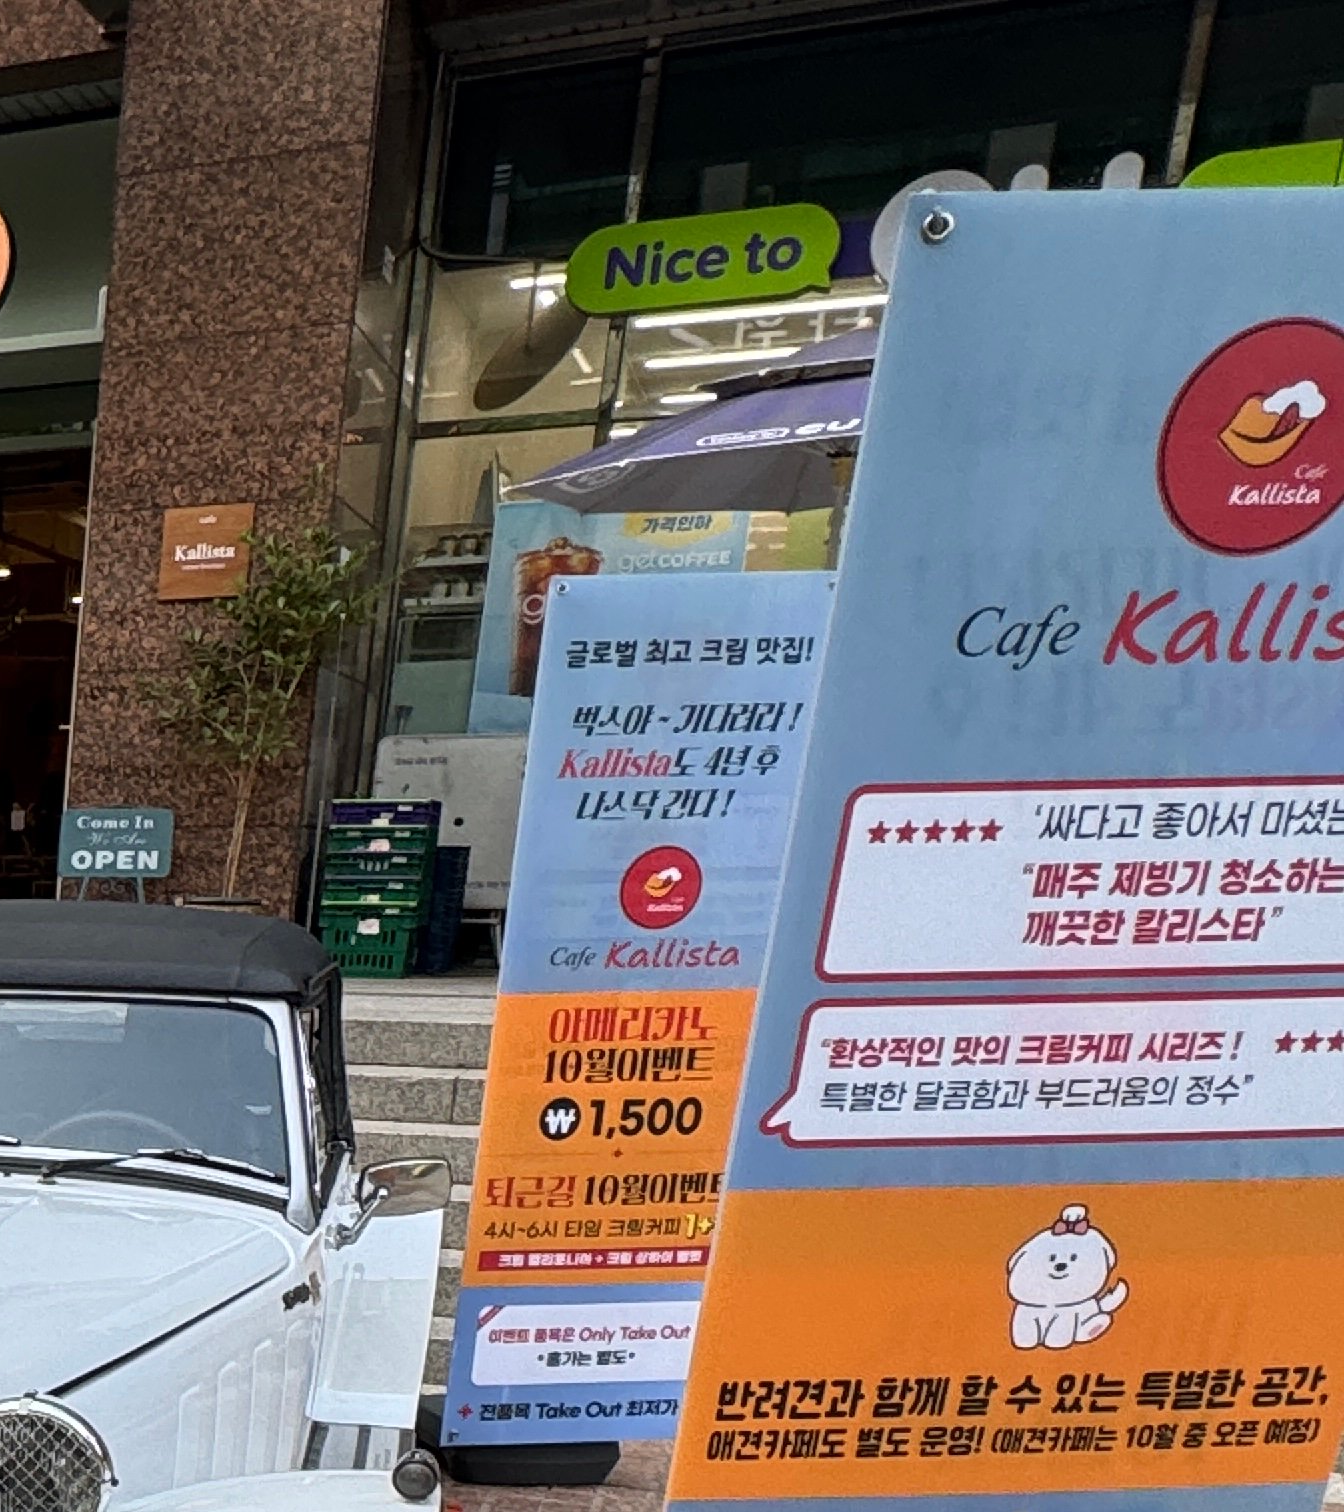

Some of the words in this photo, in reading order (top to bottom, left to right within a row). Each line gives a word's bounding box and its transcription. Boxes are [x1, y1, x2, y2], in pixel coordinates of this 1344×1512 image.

[603, 240, 730, 290] Nice
[744, 232, 803, 275] to
[1226, 483, 1323, 506] Kallista
[174, 542, 236, 561] Kallista
[566, 640, 638, 668] 글로벌
[643, 639, 692, 666] 최고
[699, 638, 749, 666] 크림
[756, 636, 815, 665] 맛집!
[955, 603, 1082, 672] Cafe
[76, 815, 130, 829] Come
[134, 815, 154, 829] In
[1152, 800, 1254, 840] 좋아서
[70, 850, 159, 870] OPEN
[1108, 858, 1212, 898] 제빙기
[1021, 909, 1126, 948] 깨끗한
[549, 945, 597, 972] Cafe
[603, 939, 740, 969] Kallista
[548, 1005, 718, 1044] 아메리카노
[952, 1032, 1012, 1068] 맛의
[1015, 1030, 1131, 1066] 크림커피
[819, 1079, 908, 1115] 특별한
[912, 1078, 1030, 1113] 달콤함과
[1035, 1075, 1180, 1110] 부드러움의
[590, 1097, 704, 1141] 1,500
[484, 1174, 579, 1209] 퇴근길
[578, 1326, 616, 1346] Only
[620, 1325, 659, 1341] Take
[660, 1324, 693, 1340] Out
[534, 1401, 582, 1420] Take
[584, 1400, 624, 1419] Out
[715, 1378, 865, 1423] 반려견과
[870, 1374, 952, 1420] 함께
[956, 1373, 998, 1417] 할
[1002, 1374, 1043, 1414] 수
[1047, 1371, 1127, 1416] 있는
[1133, 1368, 1247, 1412] 특별한
[1250, 1363, 1330, 1409] 공간,
[705, 1428, 849, 1462] 애견카페도
[854, 1424, 914, 1458] 별도
[917, 1423, 987, 1458] 운영!
[1124, 1420, 1176, 1451] 10월
[1180, 1420, 1208, 1449] 중
[1209, 1418, 1260, 1447] 오픈
[1262, 1416, 1322, 1446] 예정)
